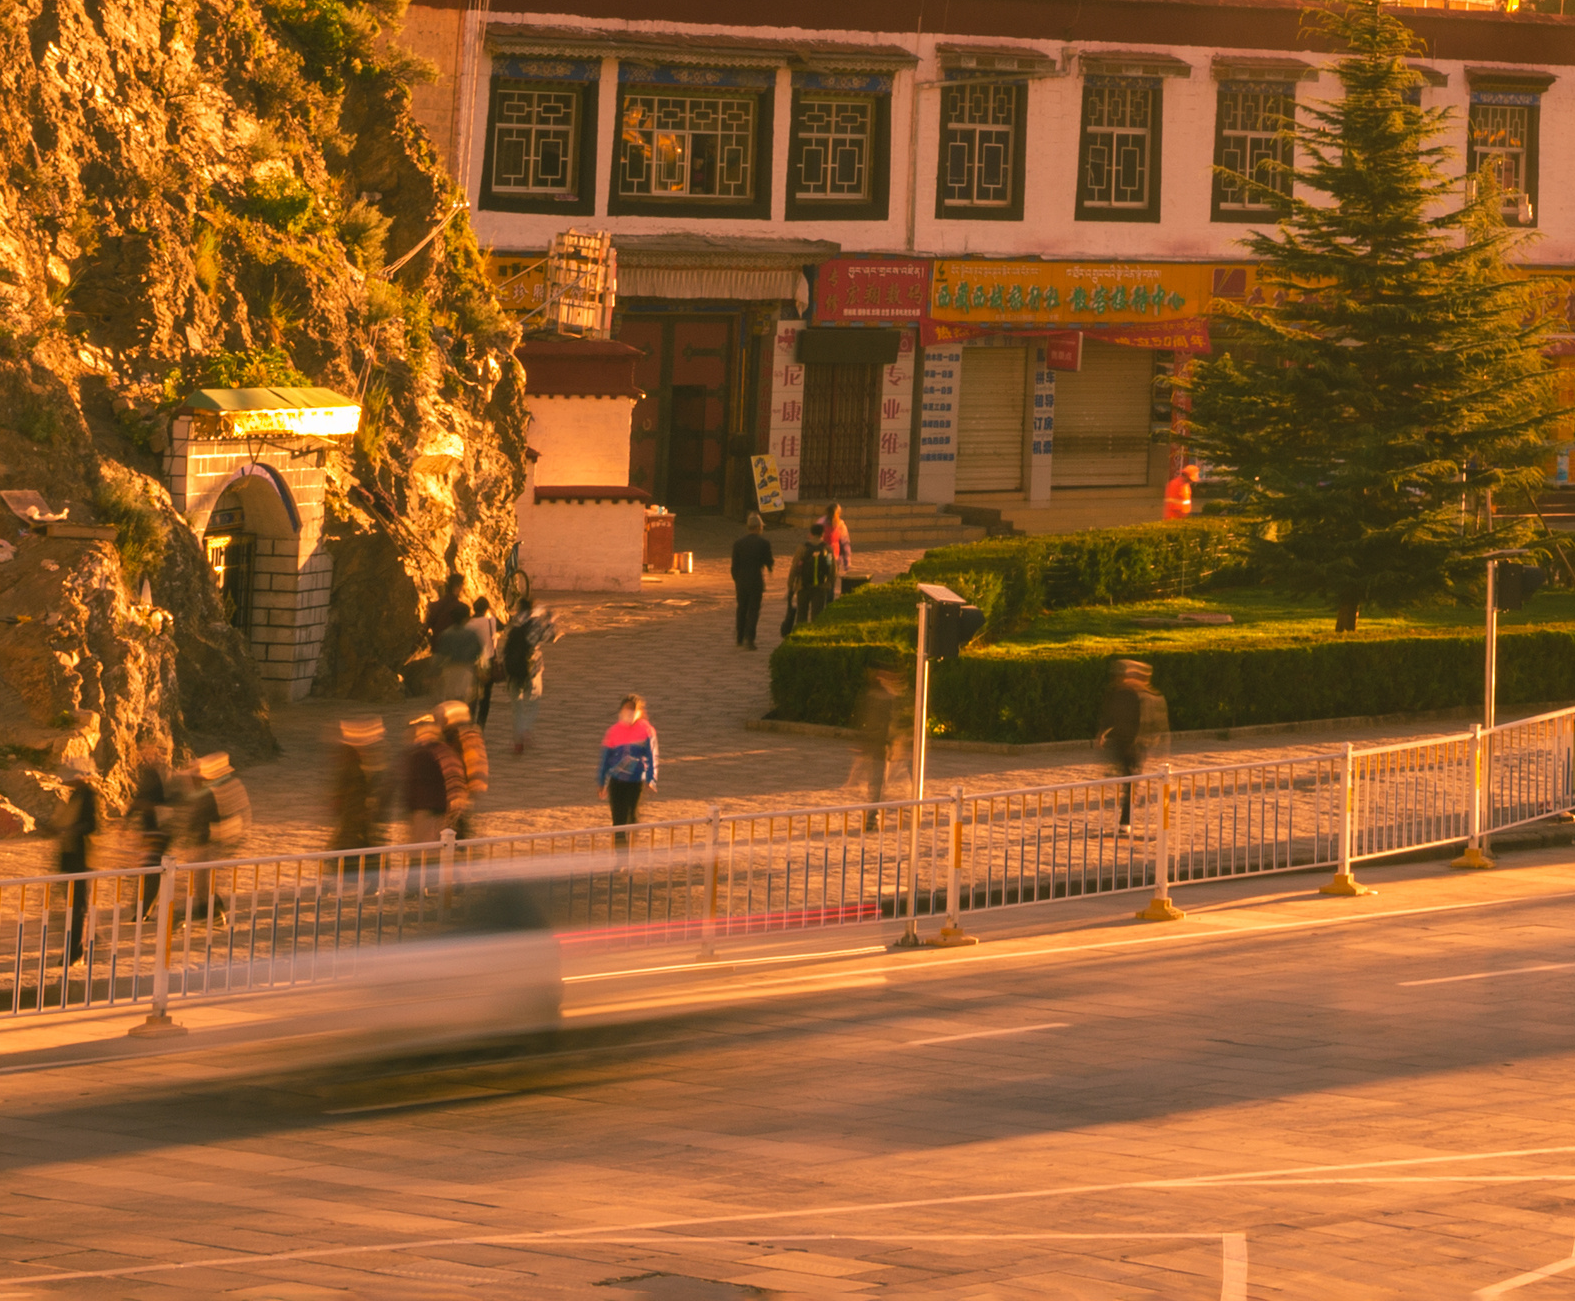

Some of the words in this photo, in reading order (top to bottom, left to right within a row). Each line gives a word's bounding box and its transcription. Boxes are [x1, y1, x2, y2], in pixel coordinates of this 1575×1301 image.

[936, 280, 1060, 314] 西藏西域旅行社
[1067, 284, 1185, 316] 散客接待中心
